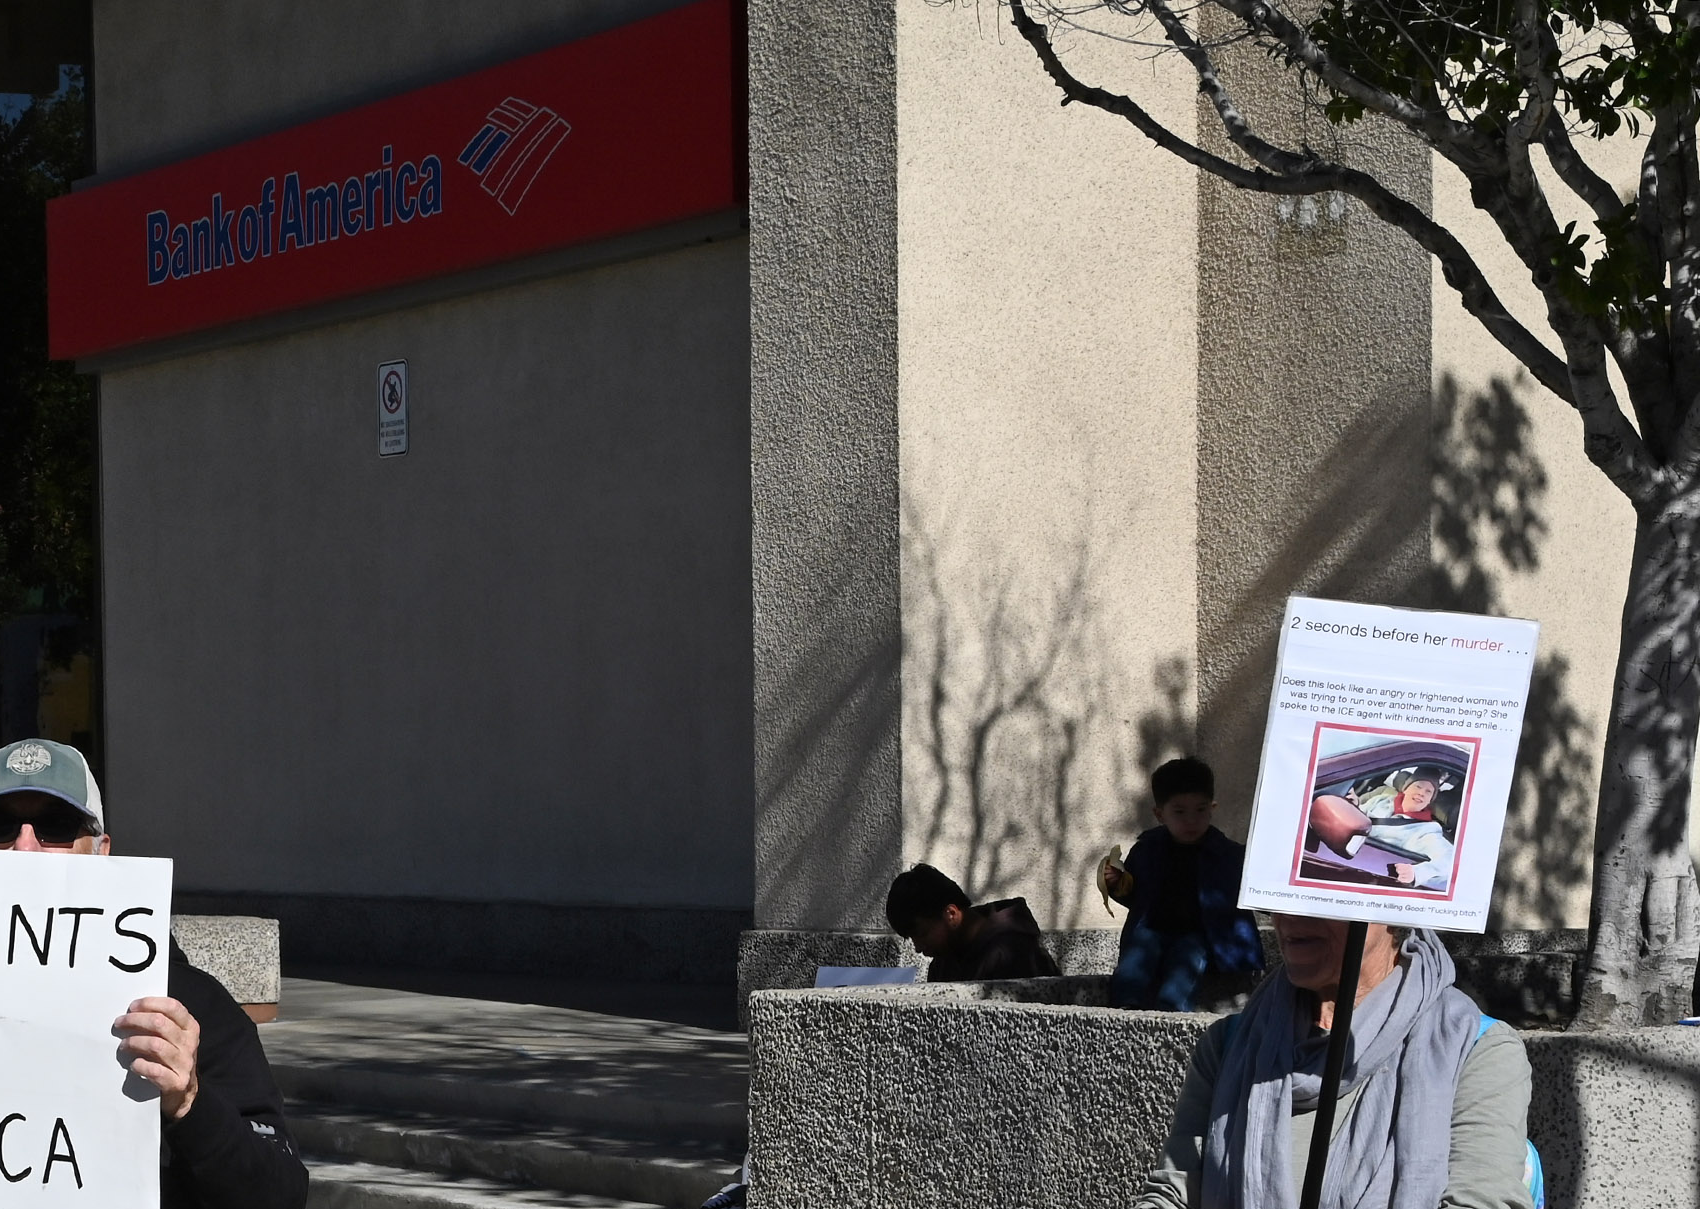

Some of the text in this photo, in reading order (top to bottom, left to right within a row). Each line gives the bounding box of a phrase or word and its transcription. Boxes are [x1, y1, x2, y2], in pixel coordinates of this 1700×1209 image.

[147, 144, 443, 286] Bank of America
[1291, 616, 1504, 652] 2 seconds before her murder
[1282, 676, 1519, 708] Does this look like an angry or frightened woman who
[1290, 691, 1308, 699] was
[1311, 692, 1336, 703] trying
[1338, 695, 1348, 703] to
[1367, 699, 1387, 708] over
[1388, 702, 1423, 711] another
[1425, 704, 1456, 714] human
[1458, 707, 1488, 719] being?
[1490, 709, 1508, 719] She
[1279, 701, 1307, 711] spoke
[1310, 703, 1319, 712] to
[1321, 705, 1336, 714] the
[1338, 707, 1355, 716] ICE
[1356, 710, 1383, 720] agent
[1384, 712, 1403, 721] with
[1405, 714, 1445, 725] kindness
[1447, 719, 1465, 728] and
[1474, 722, 1498, 731] smile
